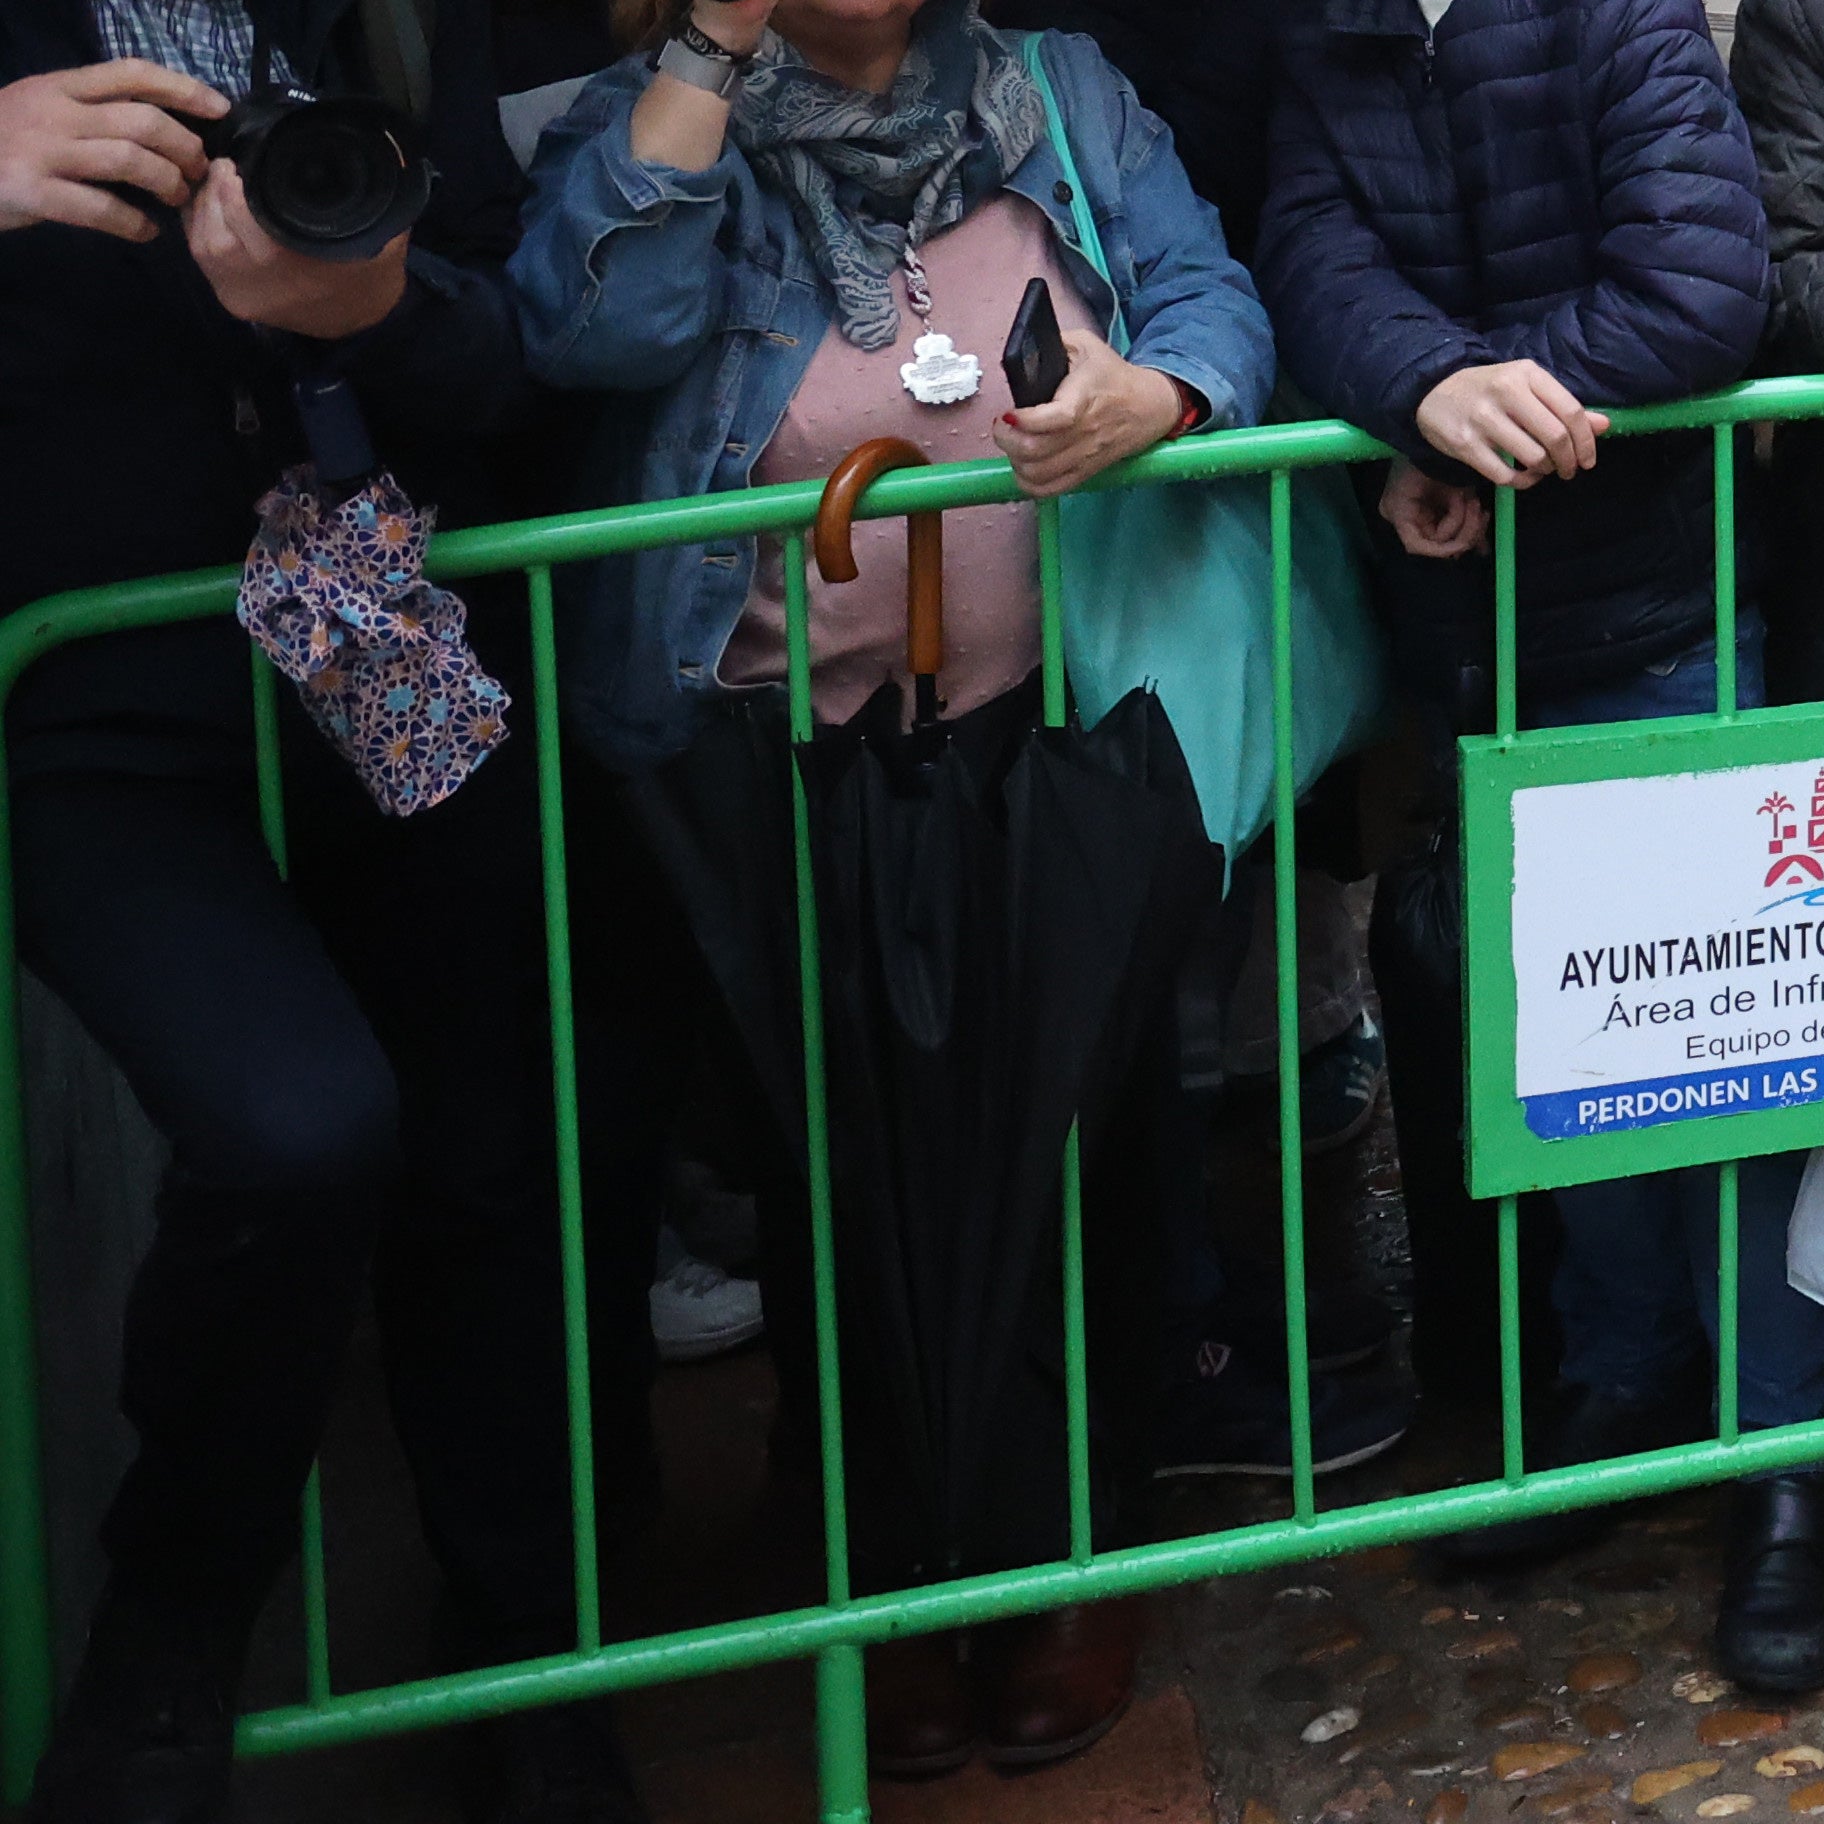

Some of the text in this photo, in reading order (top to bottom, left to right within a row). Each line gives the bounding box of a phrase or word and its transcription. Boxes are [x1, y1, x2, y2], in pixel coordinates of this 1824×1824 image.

[1602, 994, 1695, 1031] Área
[1709, 982, 1756, 1016] de
[1686, 1028, 1791, 1061] Equipo
[1579, 1076, 1750, 1126] PERDONEN
[1762, 1066, 1817, 1098] LAS
